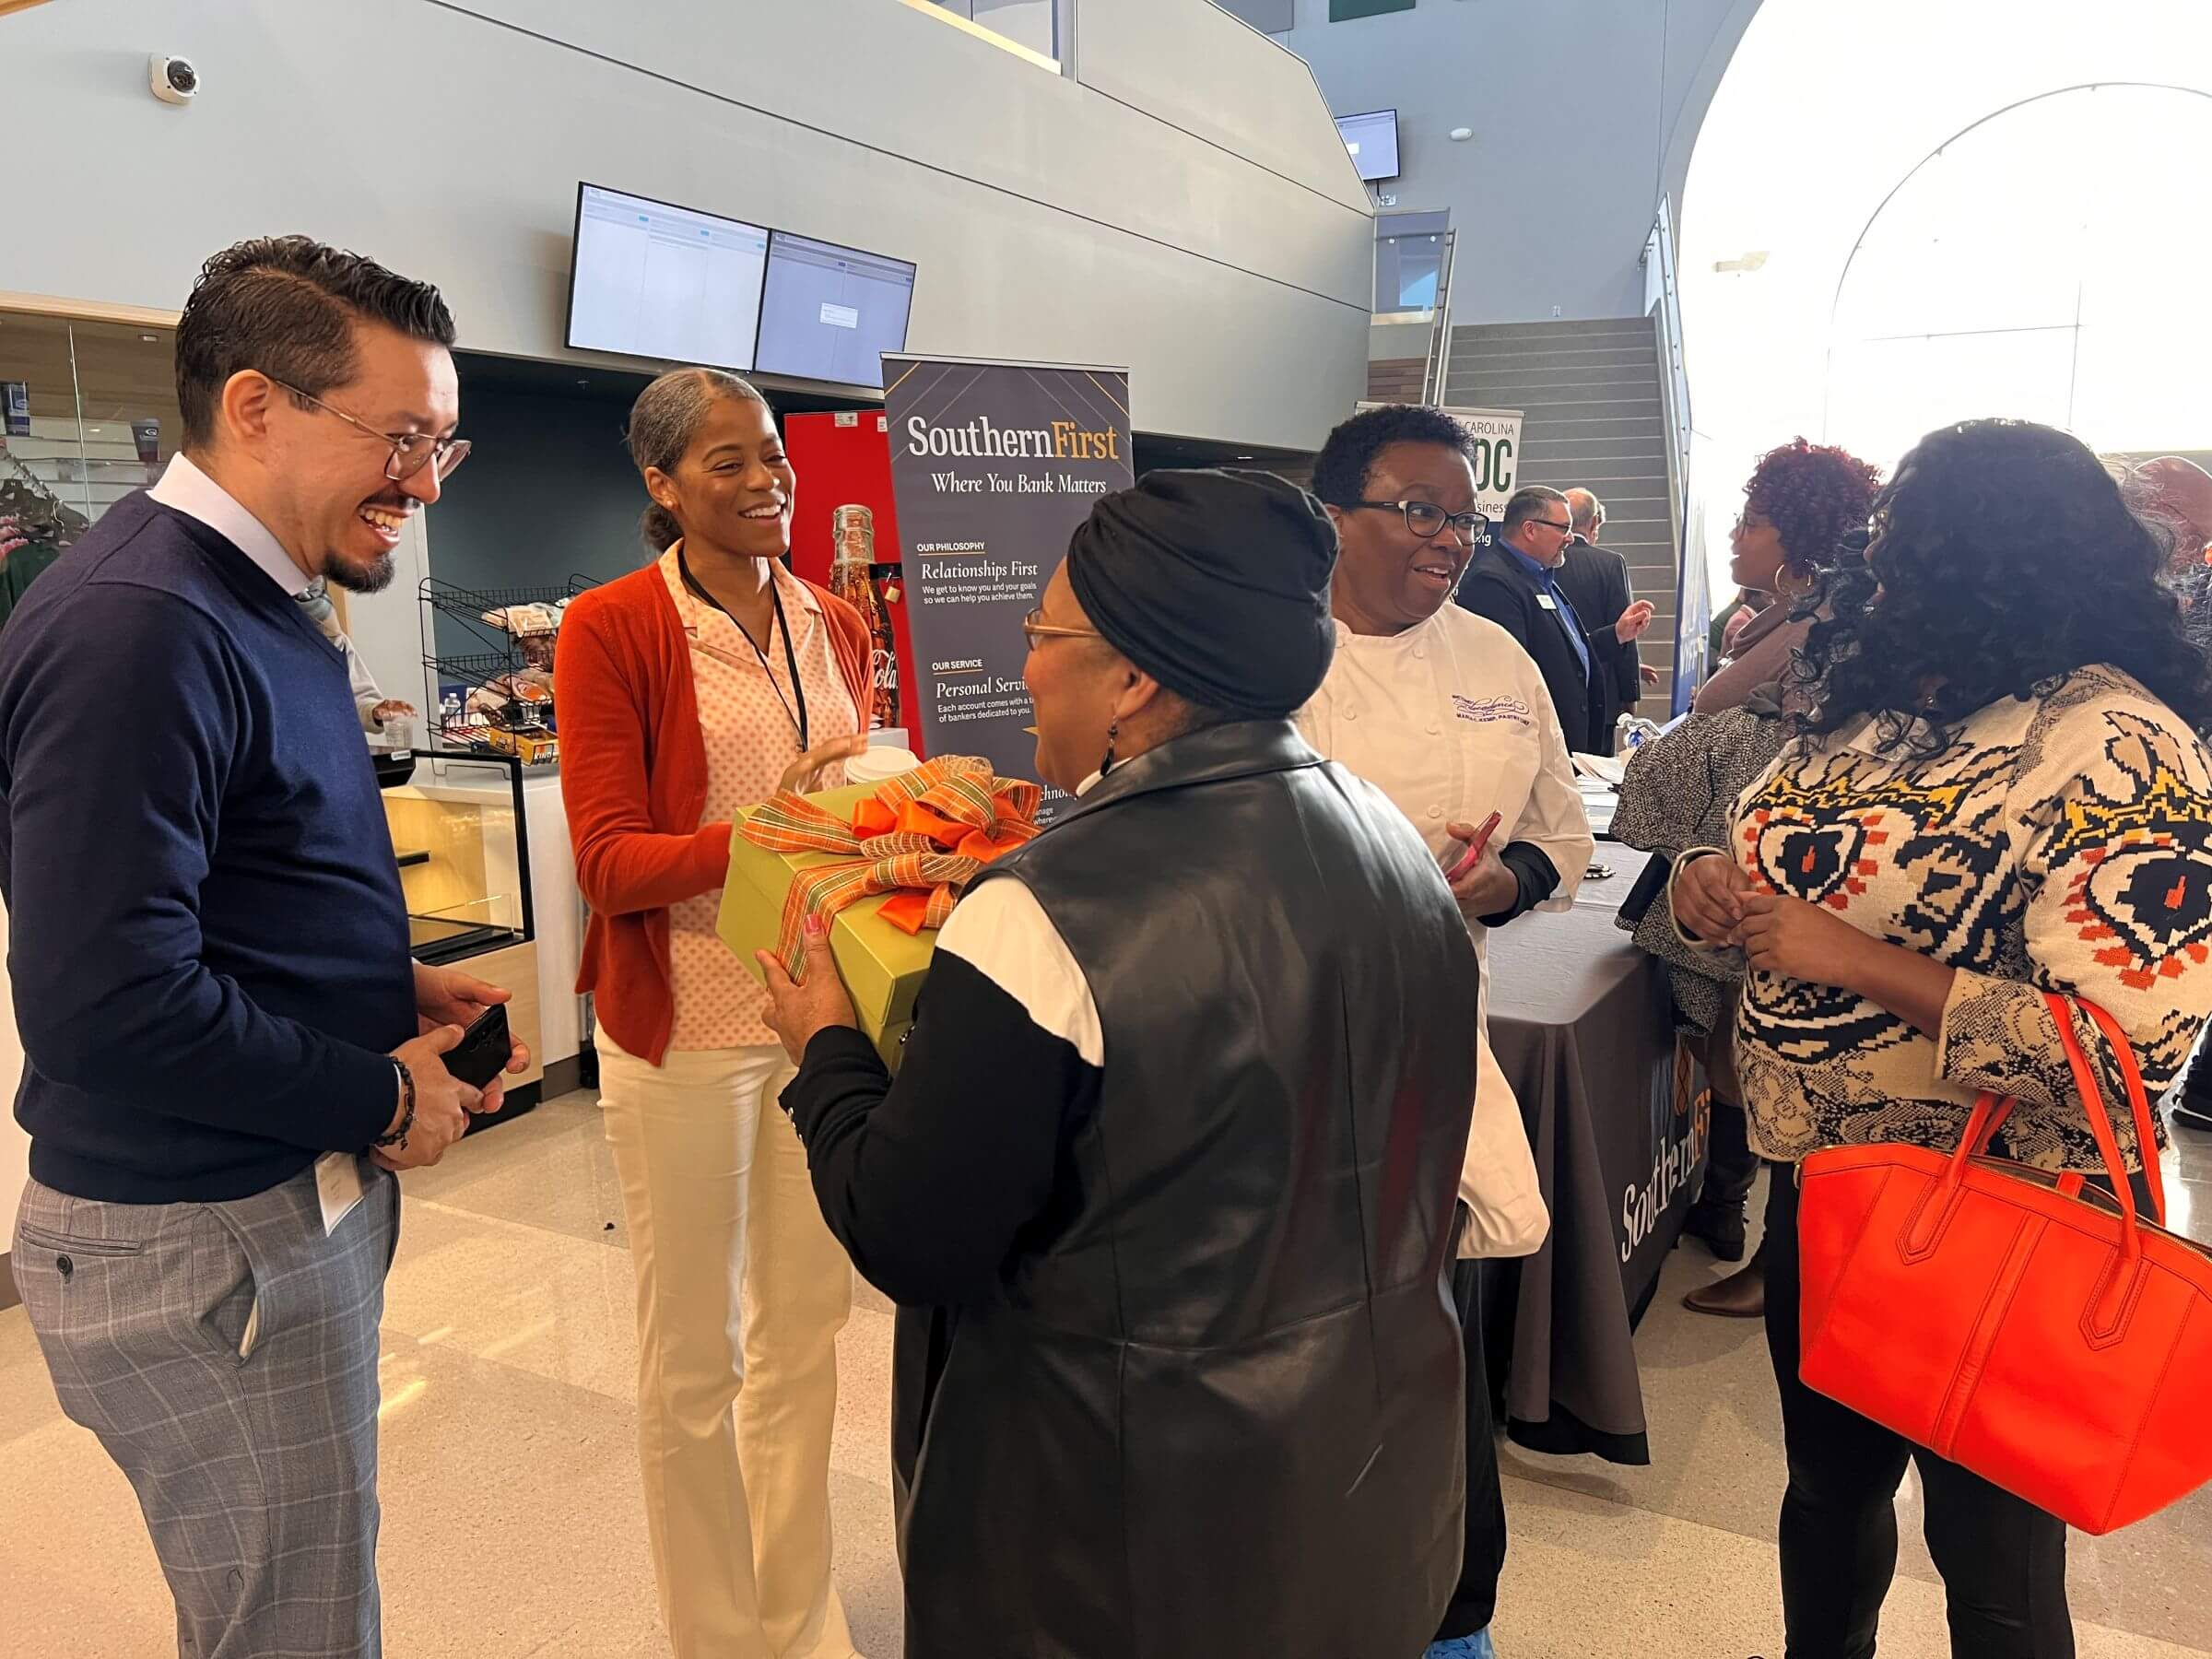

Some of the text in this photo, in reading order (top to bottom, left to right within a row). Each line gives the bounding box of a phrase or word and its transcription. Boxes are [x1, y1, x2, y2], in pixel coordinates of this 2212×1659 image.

[907, 416, 1120, 461] SouthernFirst
[1475, 438, 1512, 493] DC
[931, 470, 1107, 495] Where You Bank Matters
[916, 541, 985, 552] OUR PHILOSOPHY
[922, 559, 1039, 582] Relationships First
[922, 582, 1037, 595] We get to know you and your goals
[960, 594, 977, 604] help
[977, 594, 990, 604] you
[991, 592, 1015, 601] achieve
[1016, 592, 1034, 600] them.
[932, 659, 983, 671] OUR SERVICE
[936, 676, 1029, 699] Personal Servi
[937, 703, 957, 713] Each
[958, 701, 986, 711] account
[986, 699, 1008, 708] comes
[1009, 697, 1023, 706] with
[938, 713, 947, 724] of
[947, 712, 977, 723] bankers
[977, 708, 1009, 719] dedicated
[1621, 1088, 1712, 1263] SouthernFi
